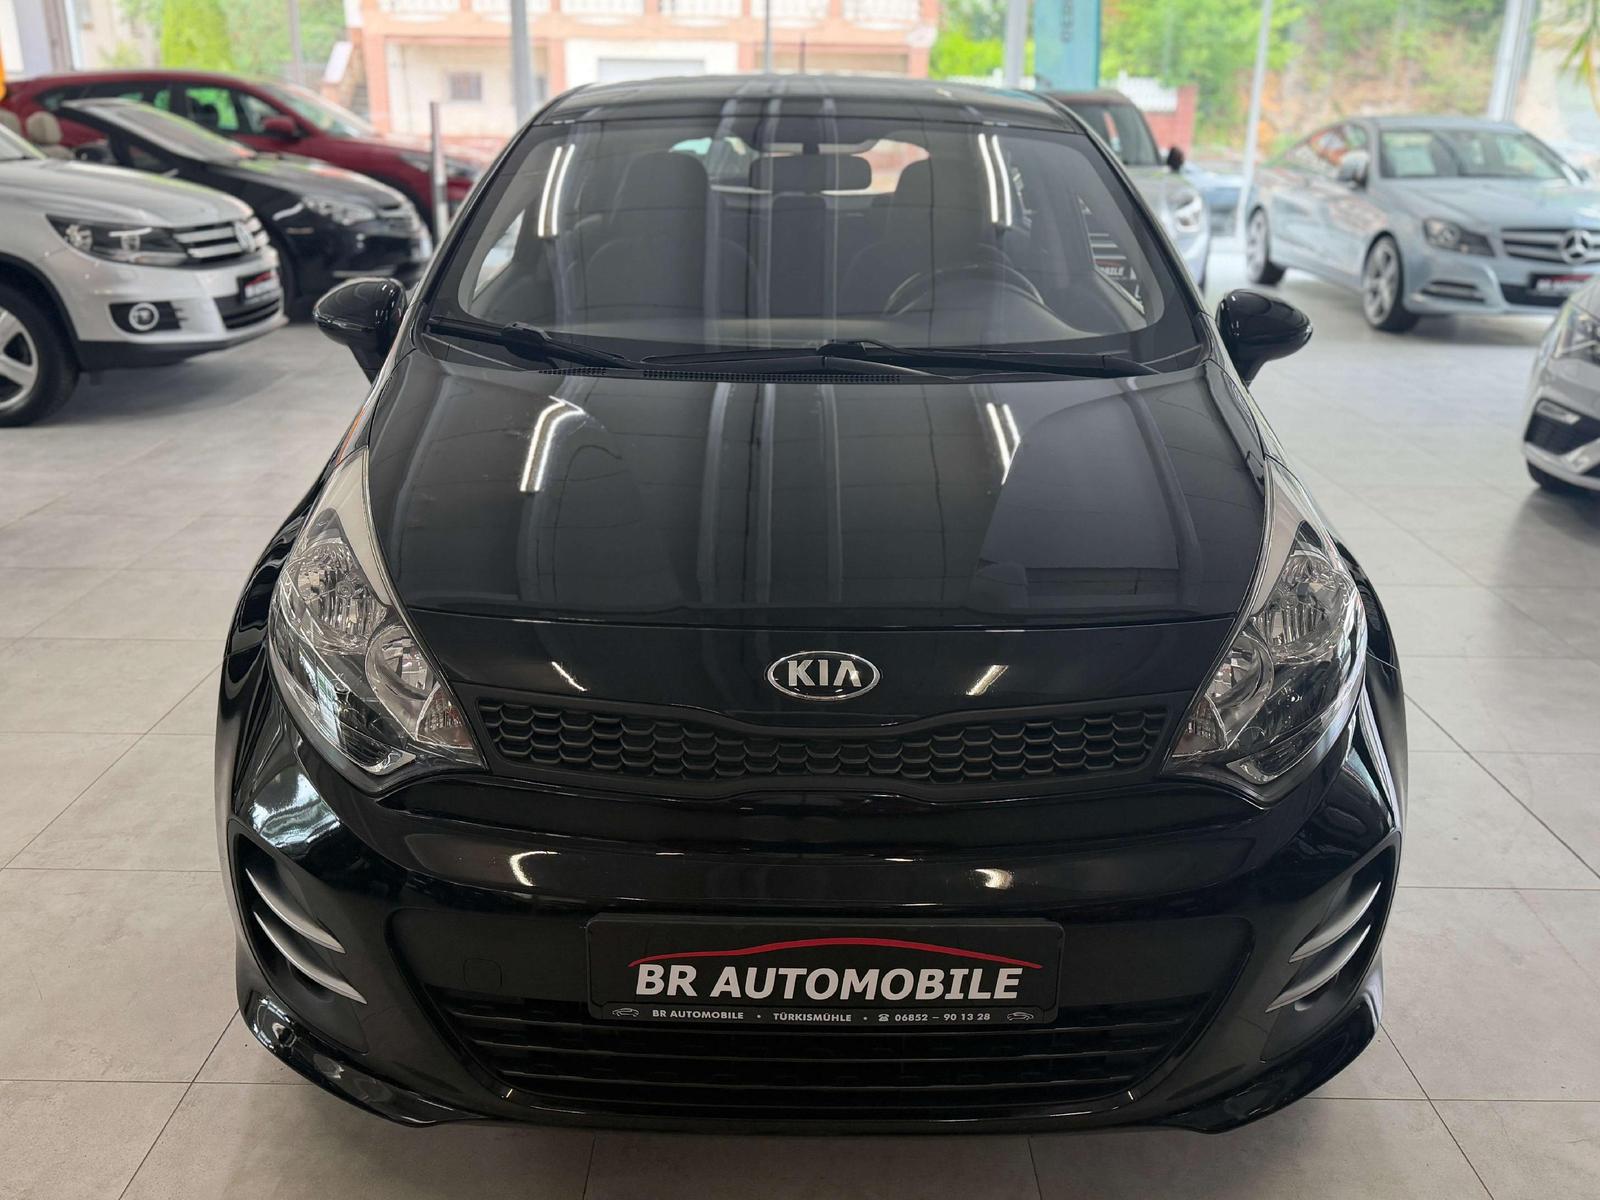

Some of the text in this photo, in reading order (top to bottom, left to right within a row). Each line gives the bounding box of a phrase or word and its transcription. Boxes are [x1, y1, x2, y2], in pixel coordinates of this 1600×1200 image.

[787, 659, 862, 687] KIA
[635, 963, 1024, 1000] BR AUTOMOBILE
[652, 1009, 667, 1018] BR
[669, 1010, 744, 1020] AUTOMOBILE
[773, 1011, 852, 1022] TÜRKISMÜHLE
[894, 1013, 928, 1022] 06852
[943, 1013, 957, 1021] 90
[961, 1013, 974, 1021] 13
[977, 1013, 991, 1021] 28
